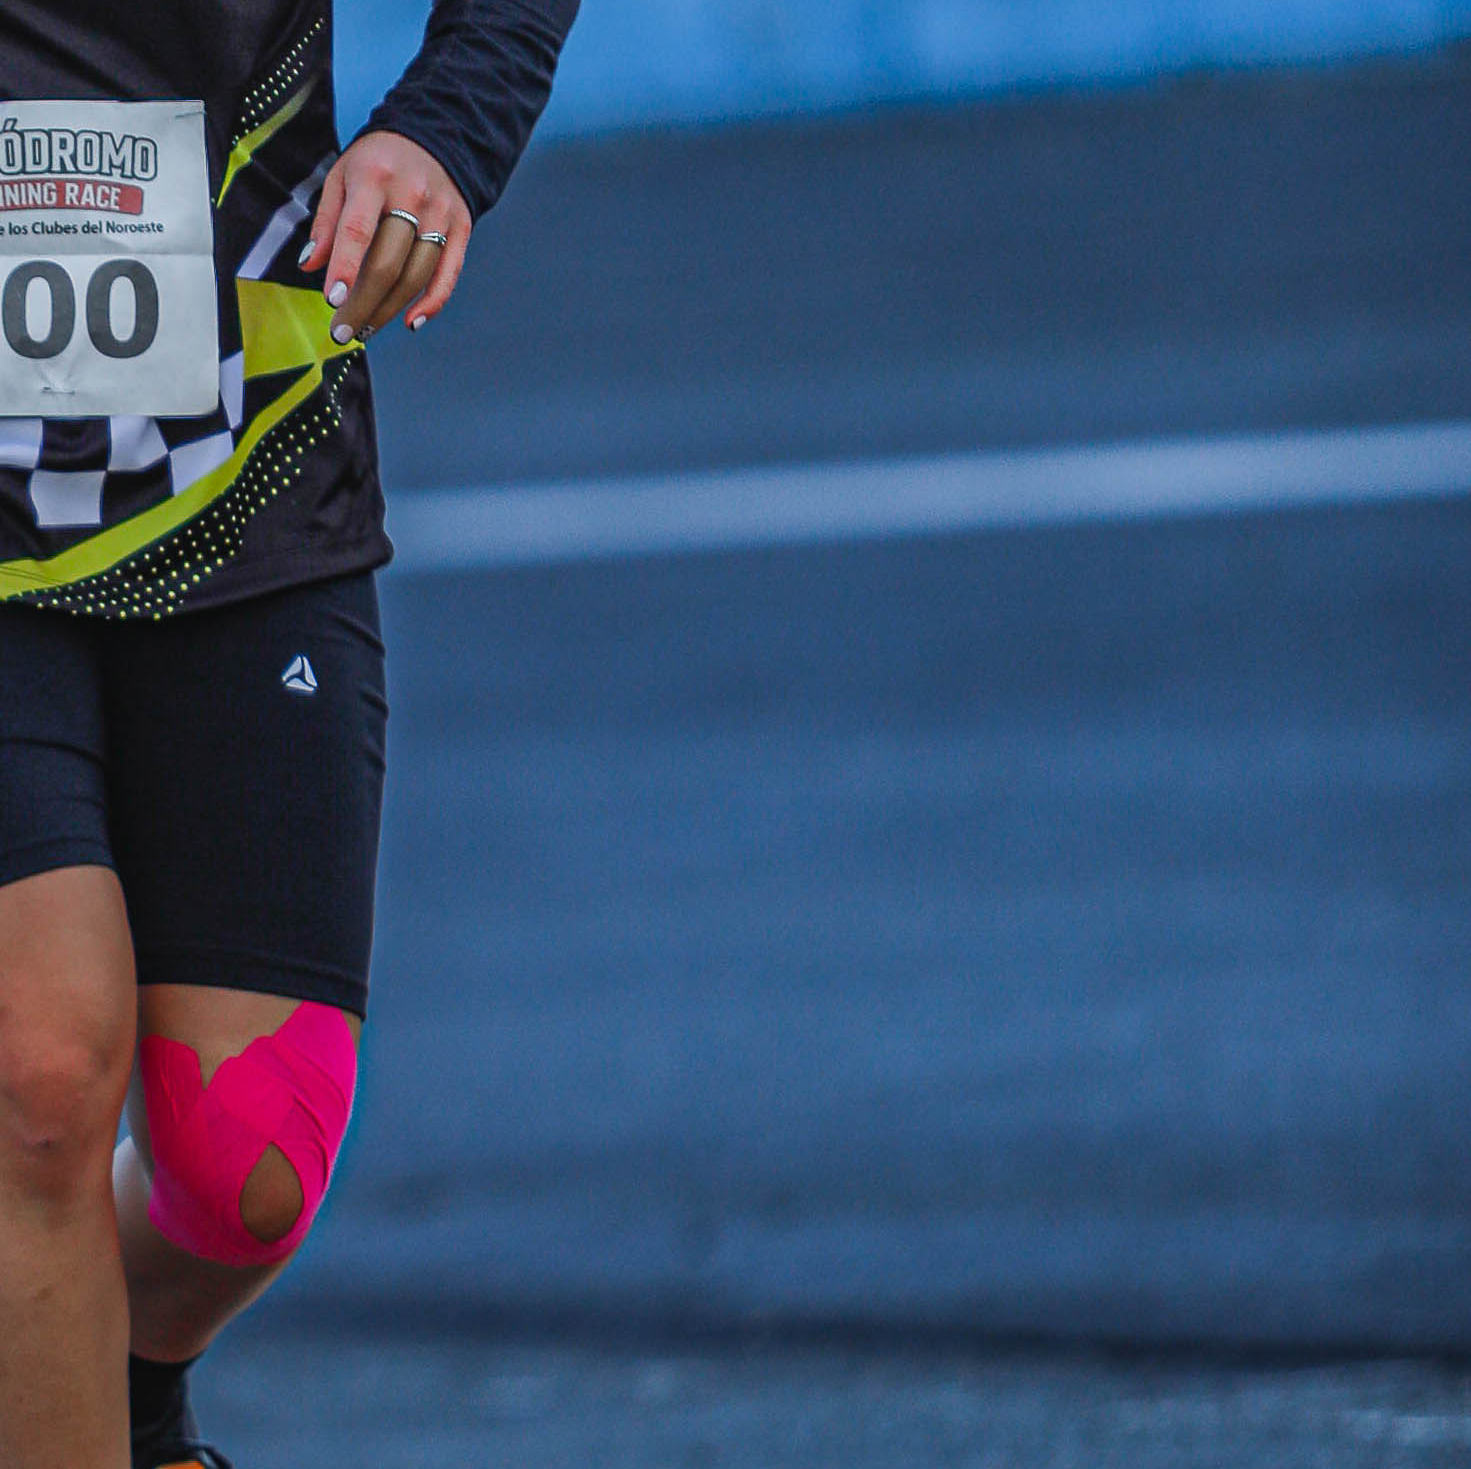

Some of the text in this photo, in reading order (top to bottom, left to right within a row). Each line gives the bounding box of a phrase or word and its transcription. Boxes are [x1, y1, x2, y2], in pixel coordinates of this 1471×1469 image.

[64, 182, 122, 211] RACE
[9, 221, 28, 236] los
[31, 220, 79, 235] Clubes
[81, 220, 103, 234] del
[106, 219, 165, 234] Noroeste
